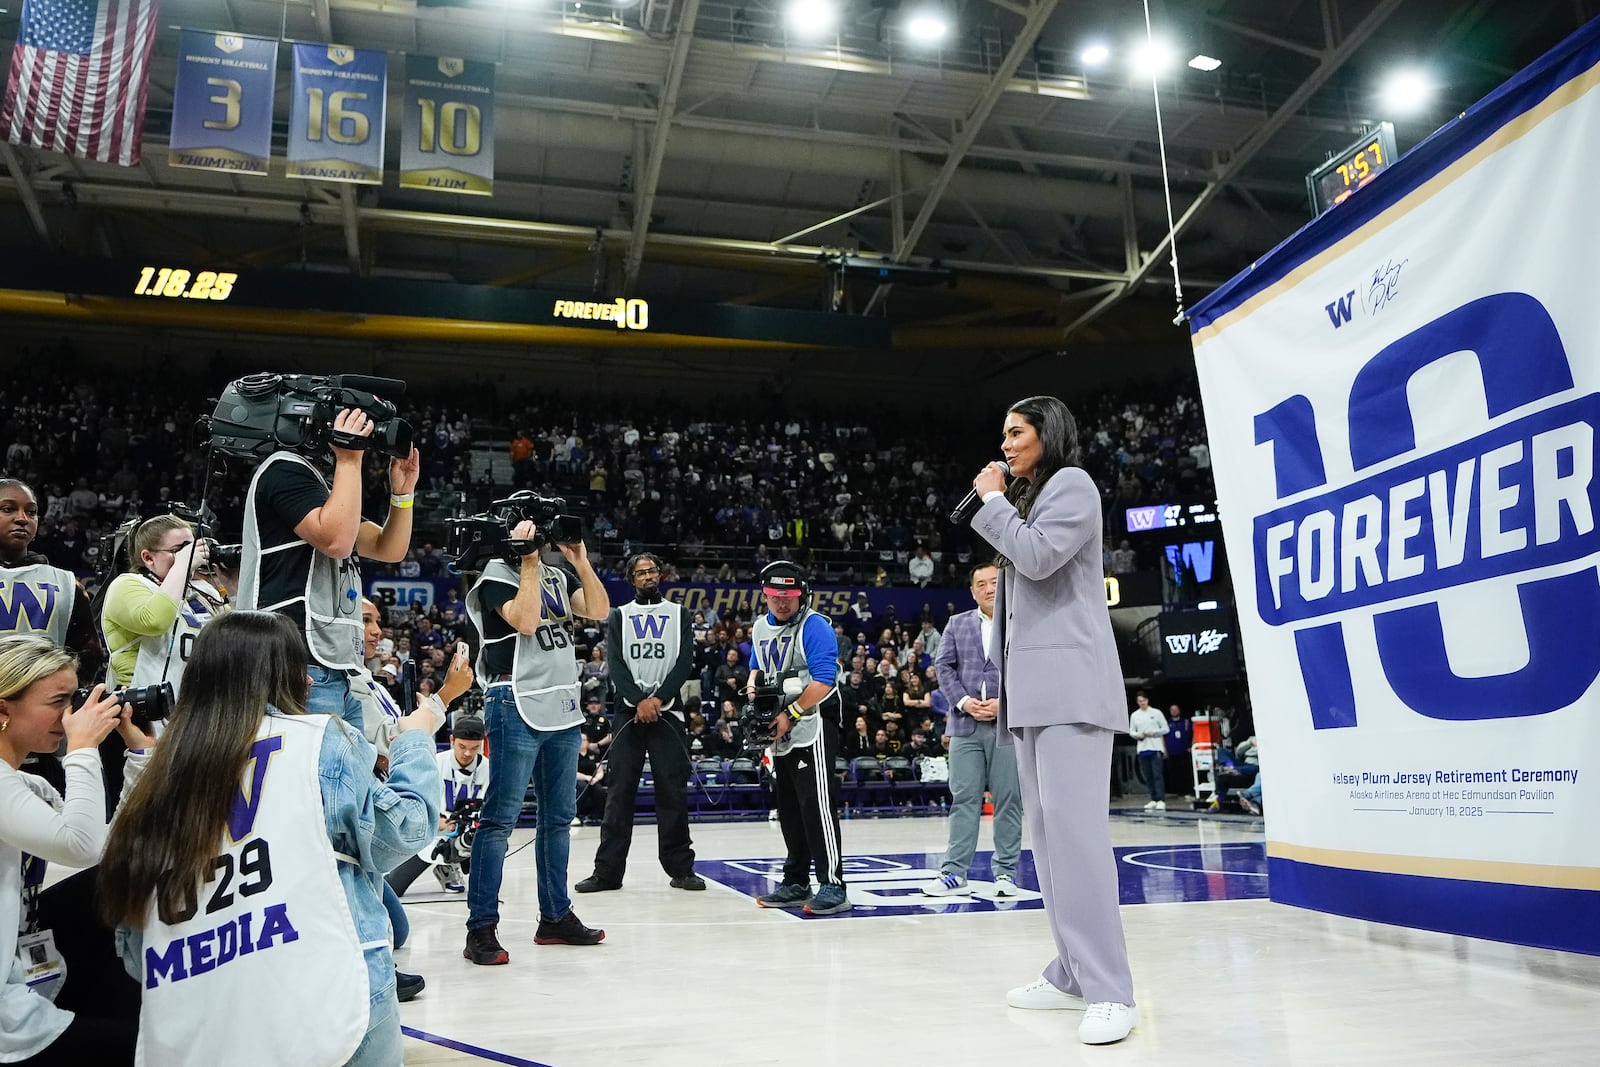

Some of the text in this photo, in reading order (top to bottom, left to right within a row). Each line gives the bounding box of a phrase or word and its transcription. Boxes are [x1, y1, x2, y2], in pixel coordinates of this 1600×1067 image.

[203, 77, 242, 130] 3
[306, 87, 371, 145] 16
[418, 97, 481, 156] 10
[178, 154, 261, 171] THOMPSON
[1336, 142, 1382, 186] 7:57
[426, 175, 467, 189] PLUM
[134, 266, 238, 301] 1.18.25
[1325, 289, 1355, 329] W
[1266, 420, 1594, 610] FOREVER
[664, 587, 707, 616] GO
[628, 613, 671, 640] W
[630, 642, 665, 660] 028
[759, 635, 793, 674] W
[1165, 634, 1191, 654] W
[1362, 771, 1390, 785] Plum
[1393, 771, 1432, 787] Jersey
[1435, 769, 1507, 784] Retirement
[1511, 768, 1578, 784] Ceremony
[1350, 789, 1554, 800] Alaska Airlines Arena at Hec Edmundson Pavilion
[1409, 805, 1483, 817] January 18, 2025
[145, 903, 299, 990] MEDIA
